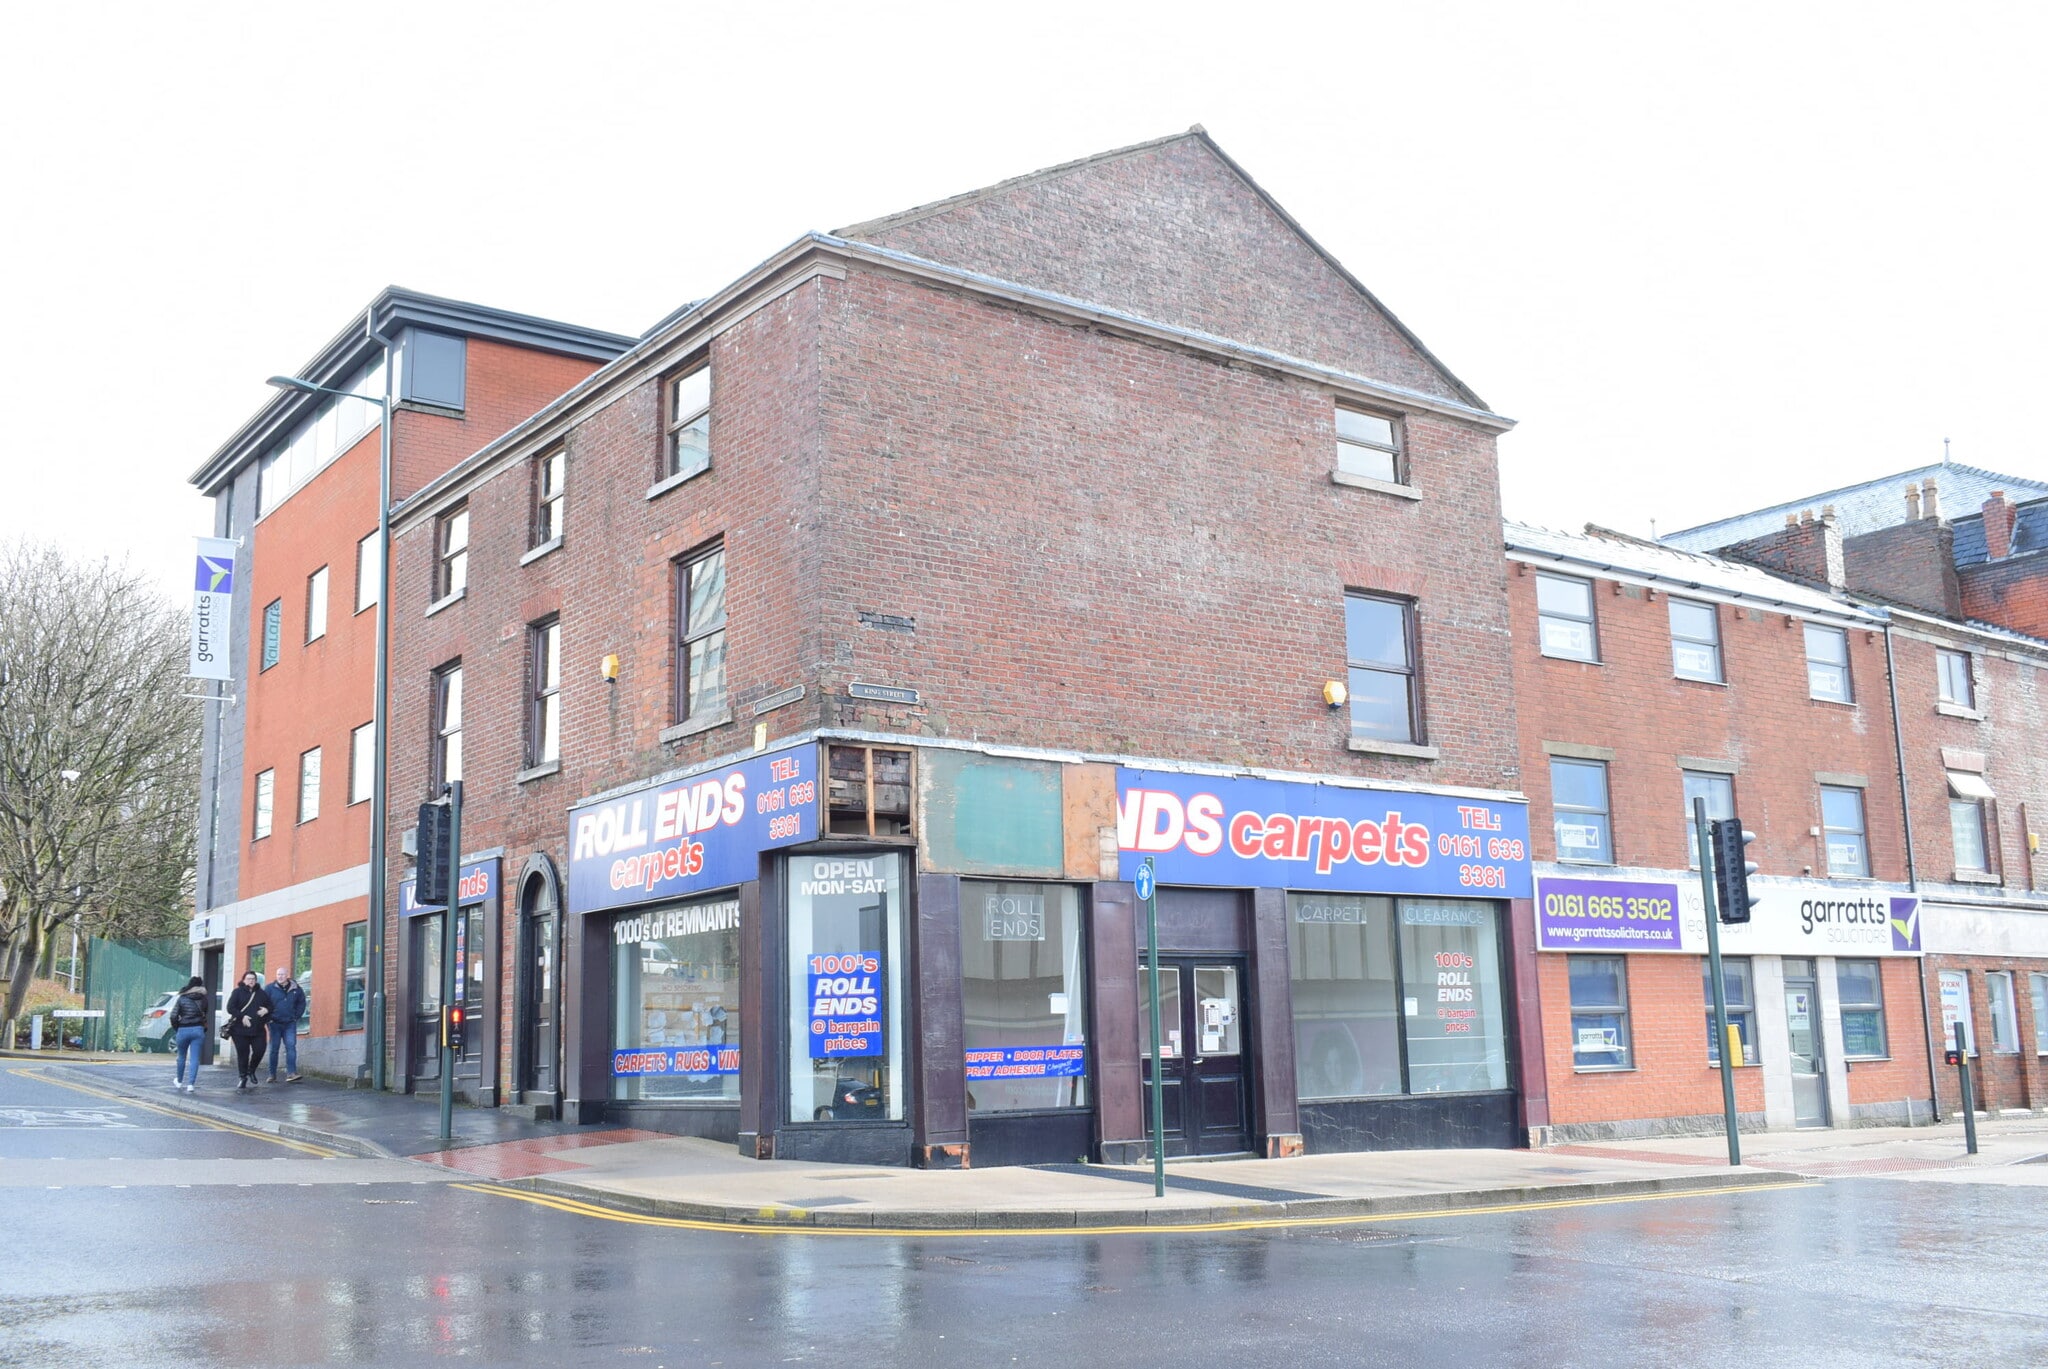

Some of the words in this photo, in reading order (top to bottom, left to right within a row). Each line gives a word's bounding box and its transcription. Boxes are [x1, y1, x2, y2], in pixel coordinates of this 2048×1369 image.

[197, 595, 213, 662] garratts
[864, 687, 880, 695] KING
[882, 690, 904, 698] STREET
[770, 757, 800, 782] TEL:
[573, 800, 648, 863] ROLL
[654, 770, 746, 842] ENDS
[757, 787, 784, 814] 0161
[789, 780, 815, 806] 633
[1457, 804, 1502, 831] TEL:
[769, 813, 801, 840] 3381
[1228, 810, 1430, 875] carpets
[1437, 833, 1482, 858] 0161
[1488, 837, 1524, 862] 633
[610, 835, 704, 892] carpets
[814, 861, 874, 880] OPEN
[458, 868, 488, 899] nds
[1458, 864, 1506, 888] 3381
[801, 878, 887, 896] MON-SAT.
[988, 897, 1040, 916] ROLL
[1301, 904, 1363, 921] CARPET
[1406, 906, 1484, 924] CLEARANCE
[1545, 894, 1586, 917] 0161
[1588, 895, 1624, 919] 665
[1626, 897, 1672, 921] 3502
[1801, 897, 1885, 935] garratts
[613, 918, 649, 945] 1000's
[653, 914, 665, 940] of
[991, 919, 1040, 936] ENDS
[1547, 924, 1674, 942] www.garrattssolicitors.co.uk
[1827, 928, 1888, 944] SOLICITORS
[810, 953, 879, 975] 100's
[1434, 951, 1473, 968] 100's
[814, 977, 876, 997] ROLL
[1437, 971, 1471, 986] ROLL
[1437, 987, 1473, 1003] ENDS
[812, 997, 879, 1017] ENDS
[1447, 1007, 1477, 1020] bargain
[811, 1019, 826, 1035] @
[829, 1018, 880, 1036] bargain
[1445, 1021, 1470, 1033] prices
[824, 1036, 868, 1054] prices
[615, 1052, 667, 1074] CARPETS
[674, 1050, 710, 1071] RUGS
[1014, 1050, 1044, 1062] DOOR
[1045, 1048, 1084, 1060] PLATES
[994, 1063, 1047, 1076] ADHESIVE
